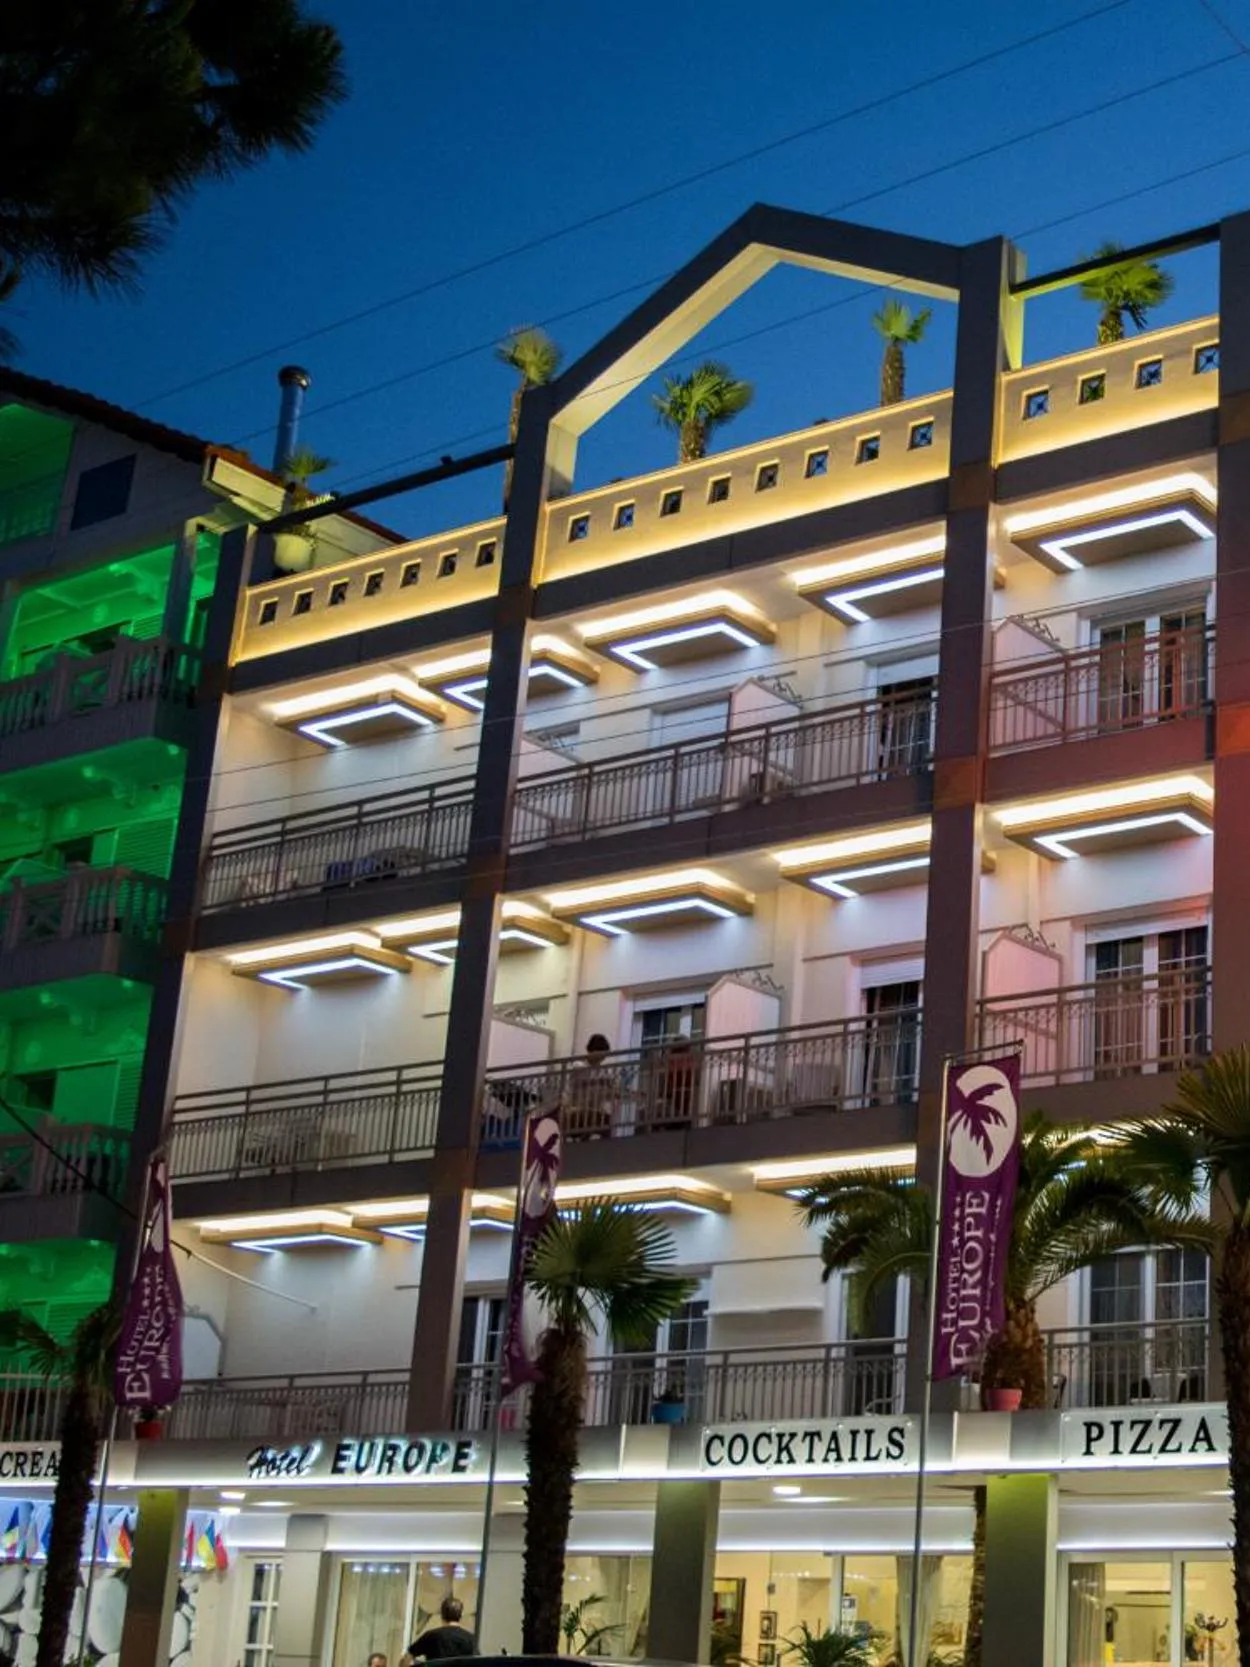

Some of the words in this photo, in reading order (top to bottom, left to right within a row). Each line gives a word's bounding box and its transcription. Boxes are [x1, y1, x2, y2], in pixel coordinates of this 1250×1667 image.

[941, 1249, 961, 1335] HOTEL
[950, 1190, 991, 1370] EUROPE
[704, 1425, 907, 1467] COCKTAILS
[1081, 1415, 1218, 1456] PIZZA
[0, 1450, 61, 1478] CREA
[330, 1438, 474, 1475] EUROPE
